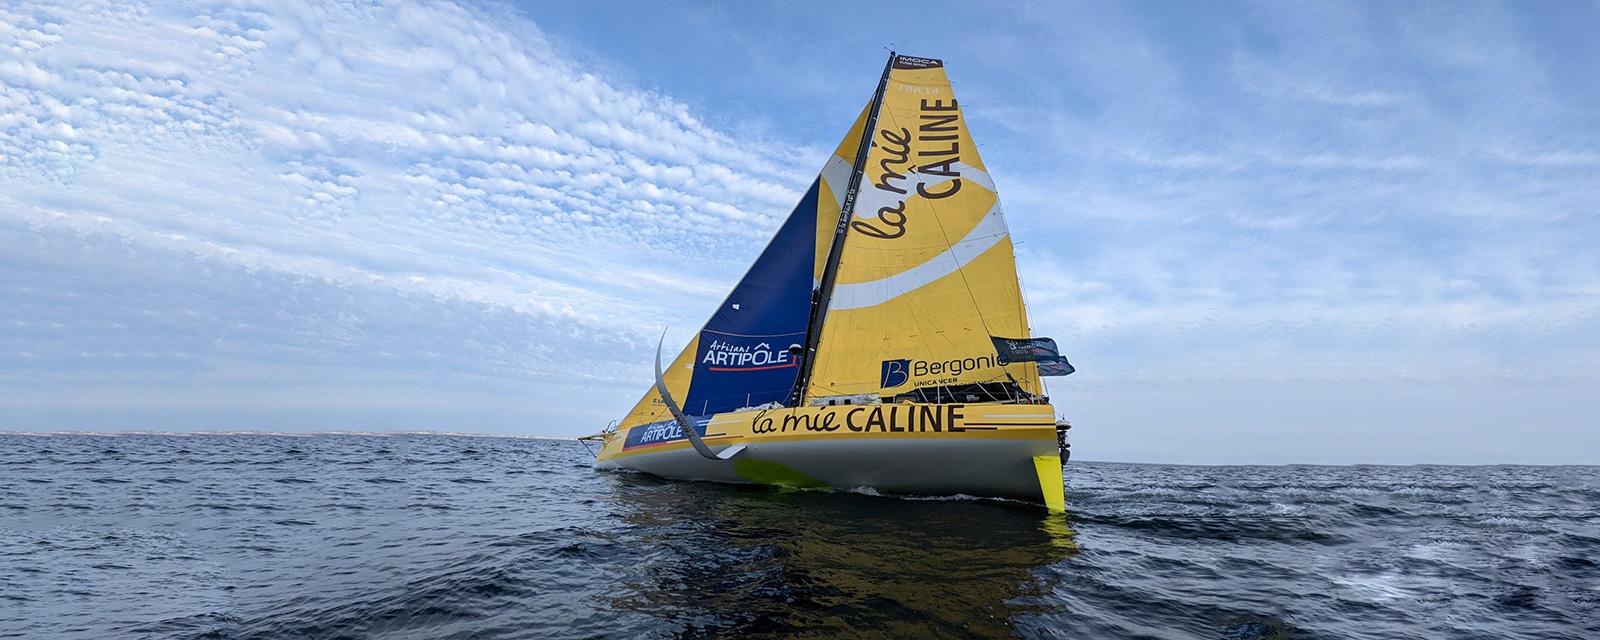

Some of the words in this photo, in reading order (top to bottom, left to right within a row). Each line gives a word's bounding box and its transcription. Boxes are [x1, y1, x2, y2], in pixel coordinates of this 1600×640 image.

[899, 56, 939, 65] IMOCA
[900, 84, 921, 94] FRA
[871, 127, 912, 195] mie
[851, 200, 906, 239] la
[709, 339, 751, 353] Artisans
[752, 404, 777, 434] la
[781, 401, 840, 433] mie
